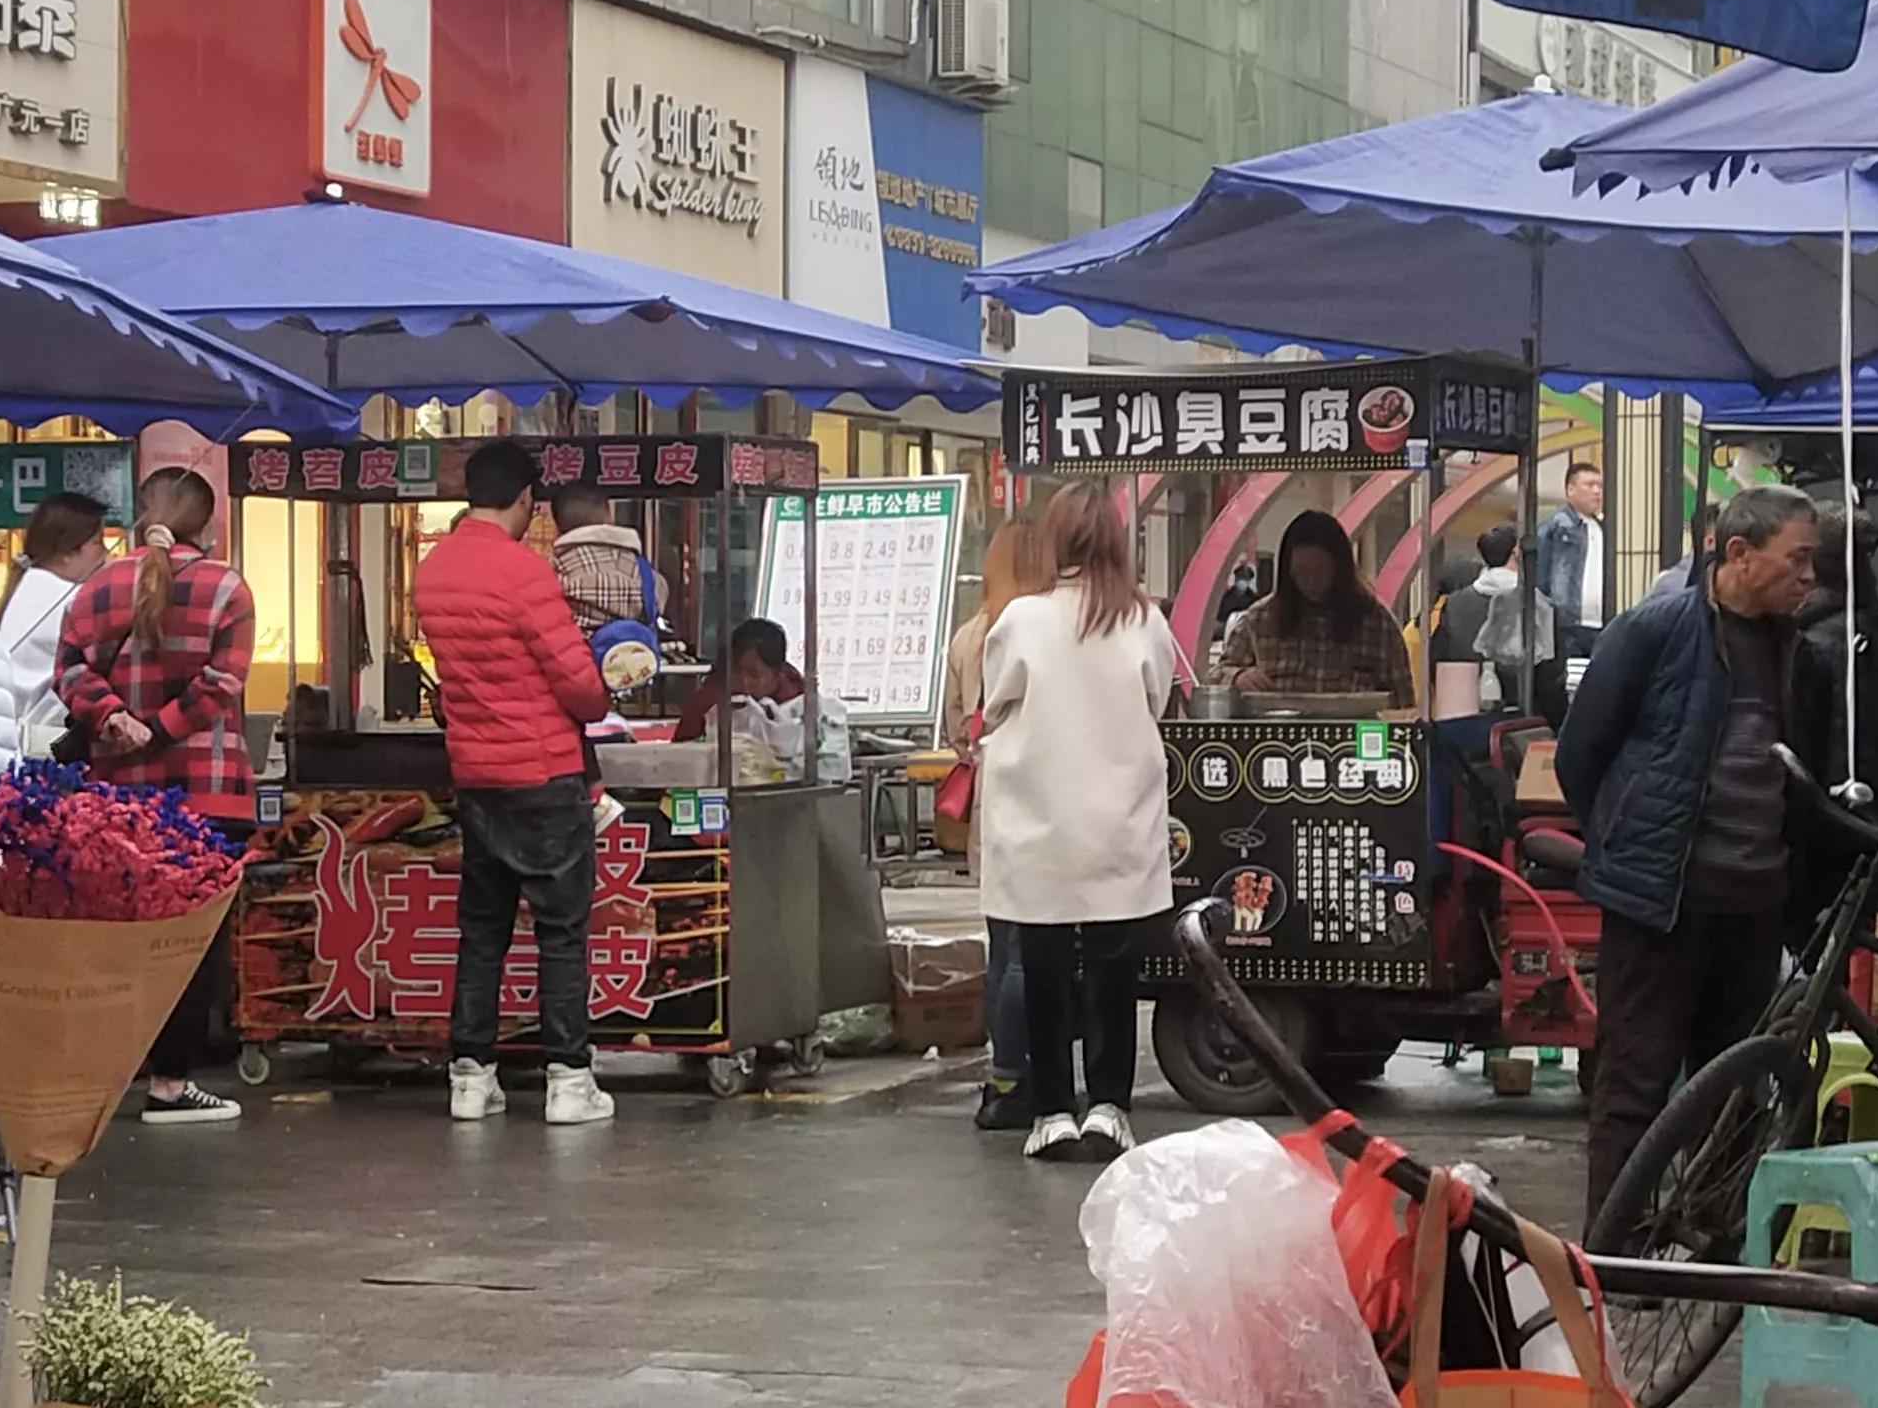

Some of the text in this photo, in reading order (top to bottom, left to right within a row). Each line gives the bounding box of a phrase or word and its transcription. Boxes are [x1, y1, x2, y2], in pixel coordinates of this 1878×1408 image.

[651, 94, 761, 184] 蜘蛛王
[1055, 387, 1351, 459] 长沙臭豆腐
[248, 447, 399, 491] 烤苕皮
[539, 442, 700, 486] 烤豆皮
[305, 813, 461, 1021] 烤
